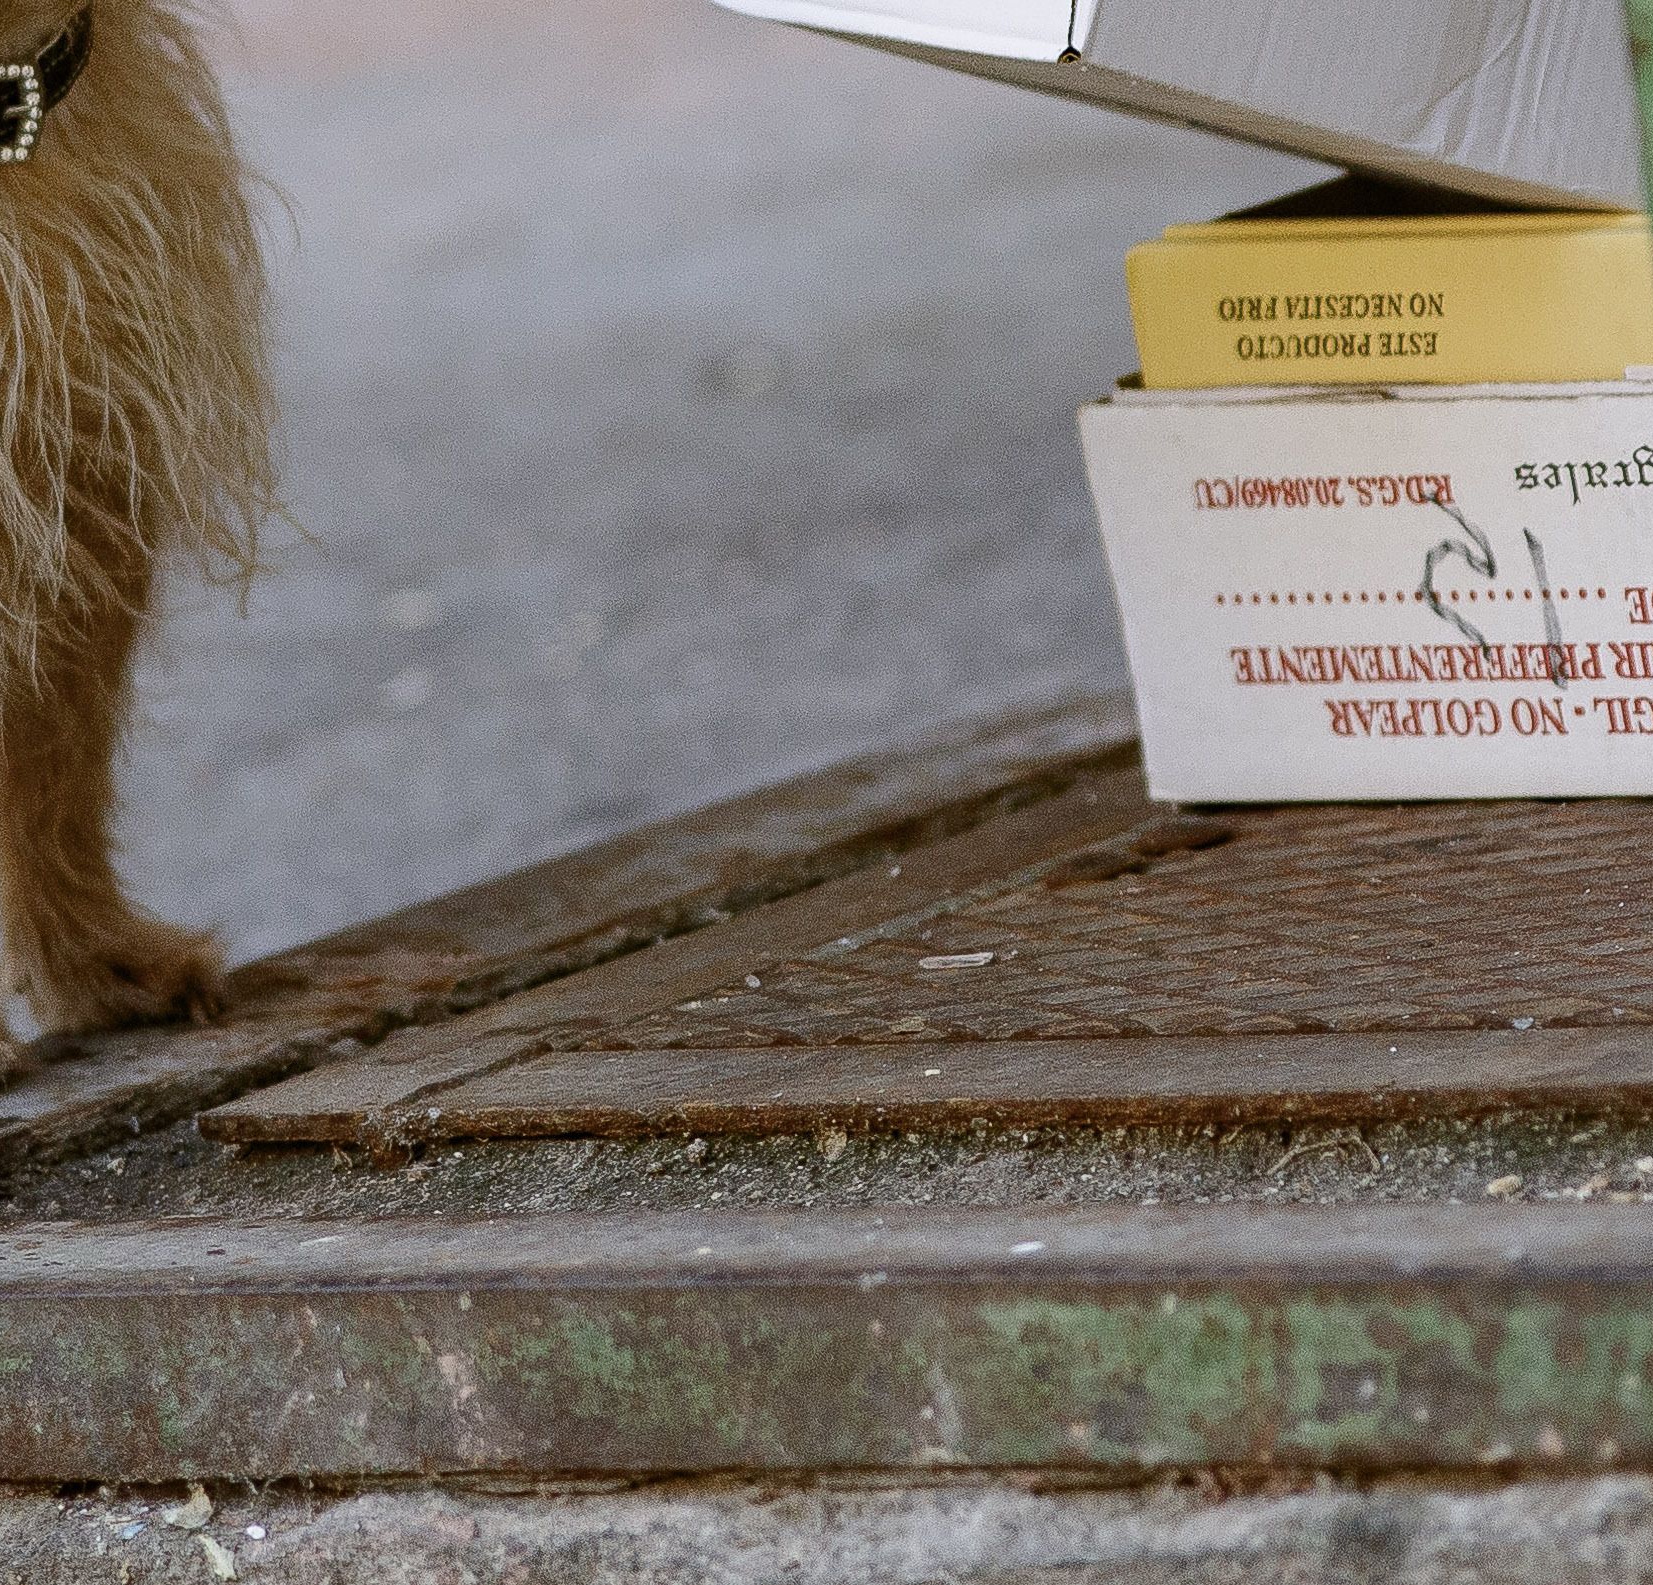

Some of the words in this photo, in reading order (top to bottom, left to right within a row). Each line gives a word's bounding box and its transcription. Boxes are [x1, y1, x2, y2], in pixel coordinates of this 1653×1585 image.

[1218, 296, 1279, 321] FRIO
[1286, 293, 1403, 320] NECESITA
[1409, 292, 1445, 318] NO
[1237, 333, 1372, 360] PRODUCTO
[1379, 332, 1438, 357] ESTE
[1347, 474, 1456, 508] R.D.G.S.
[1230, 644, 1605, 684] PREFERENTEMENTE
[1330, 698, 1502, 736] GOLPEAR
[1512, 698, 1567, 735] NO
